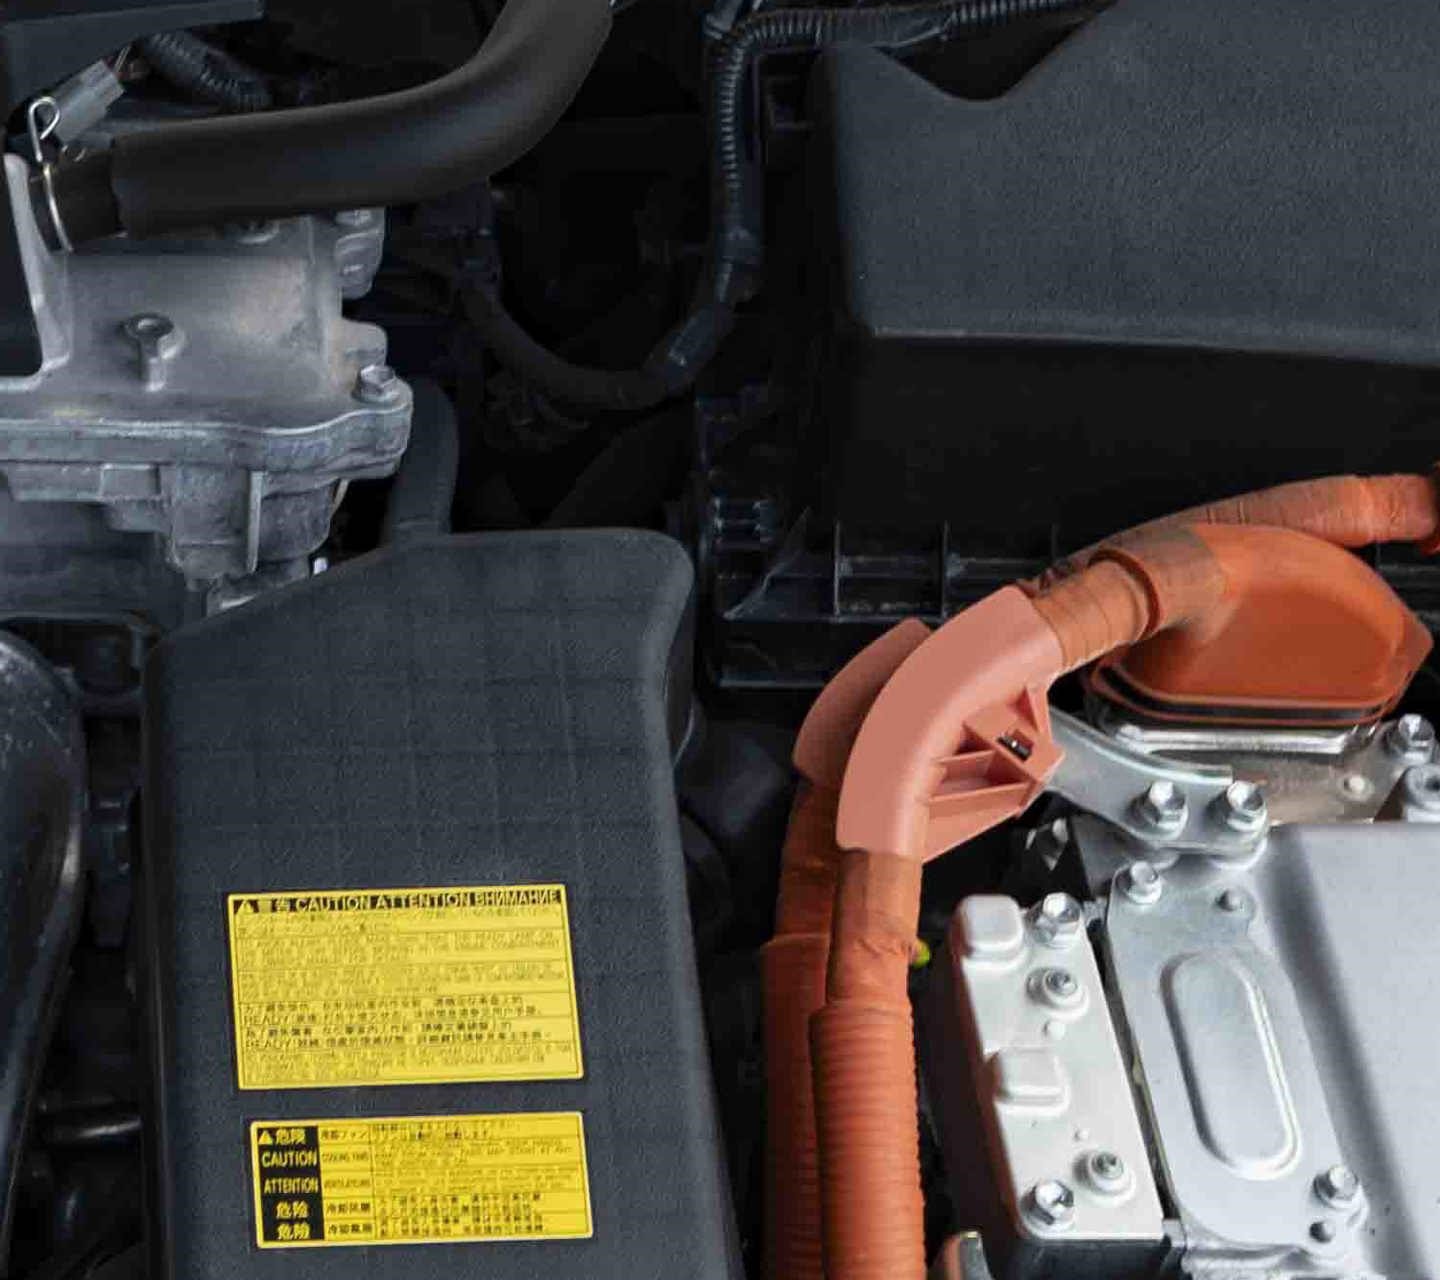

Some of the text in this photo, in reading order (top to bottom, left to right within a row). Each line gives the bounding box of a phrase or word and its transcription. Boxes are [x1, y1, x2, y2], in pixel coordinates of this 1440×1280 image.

[294, 893, 371, 913] CAUTION
[375, 891, 471, 910] ATTENTION
[262, 1149, 317, 1168] CAUTION
[264, 1177, 319, 1194] ATTENTION
